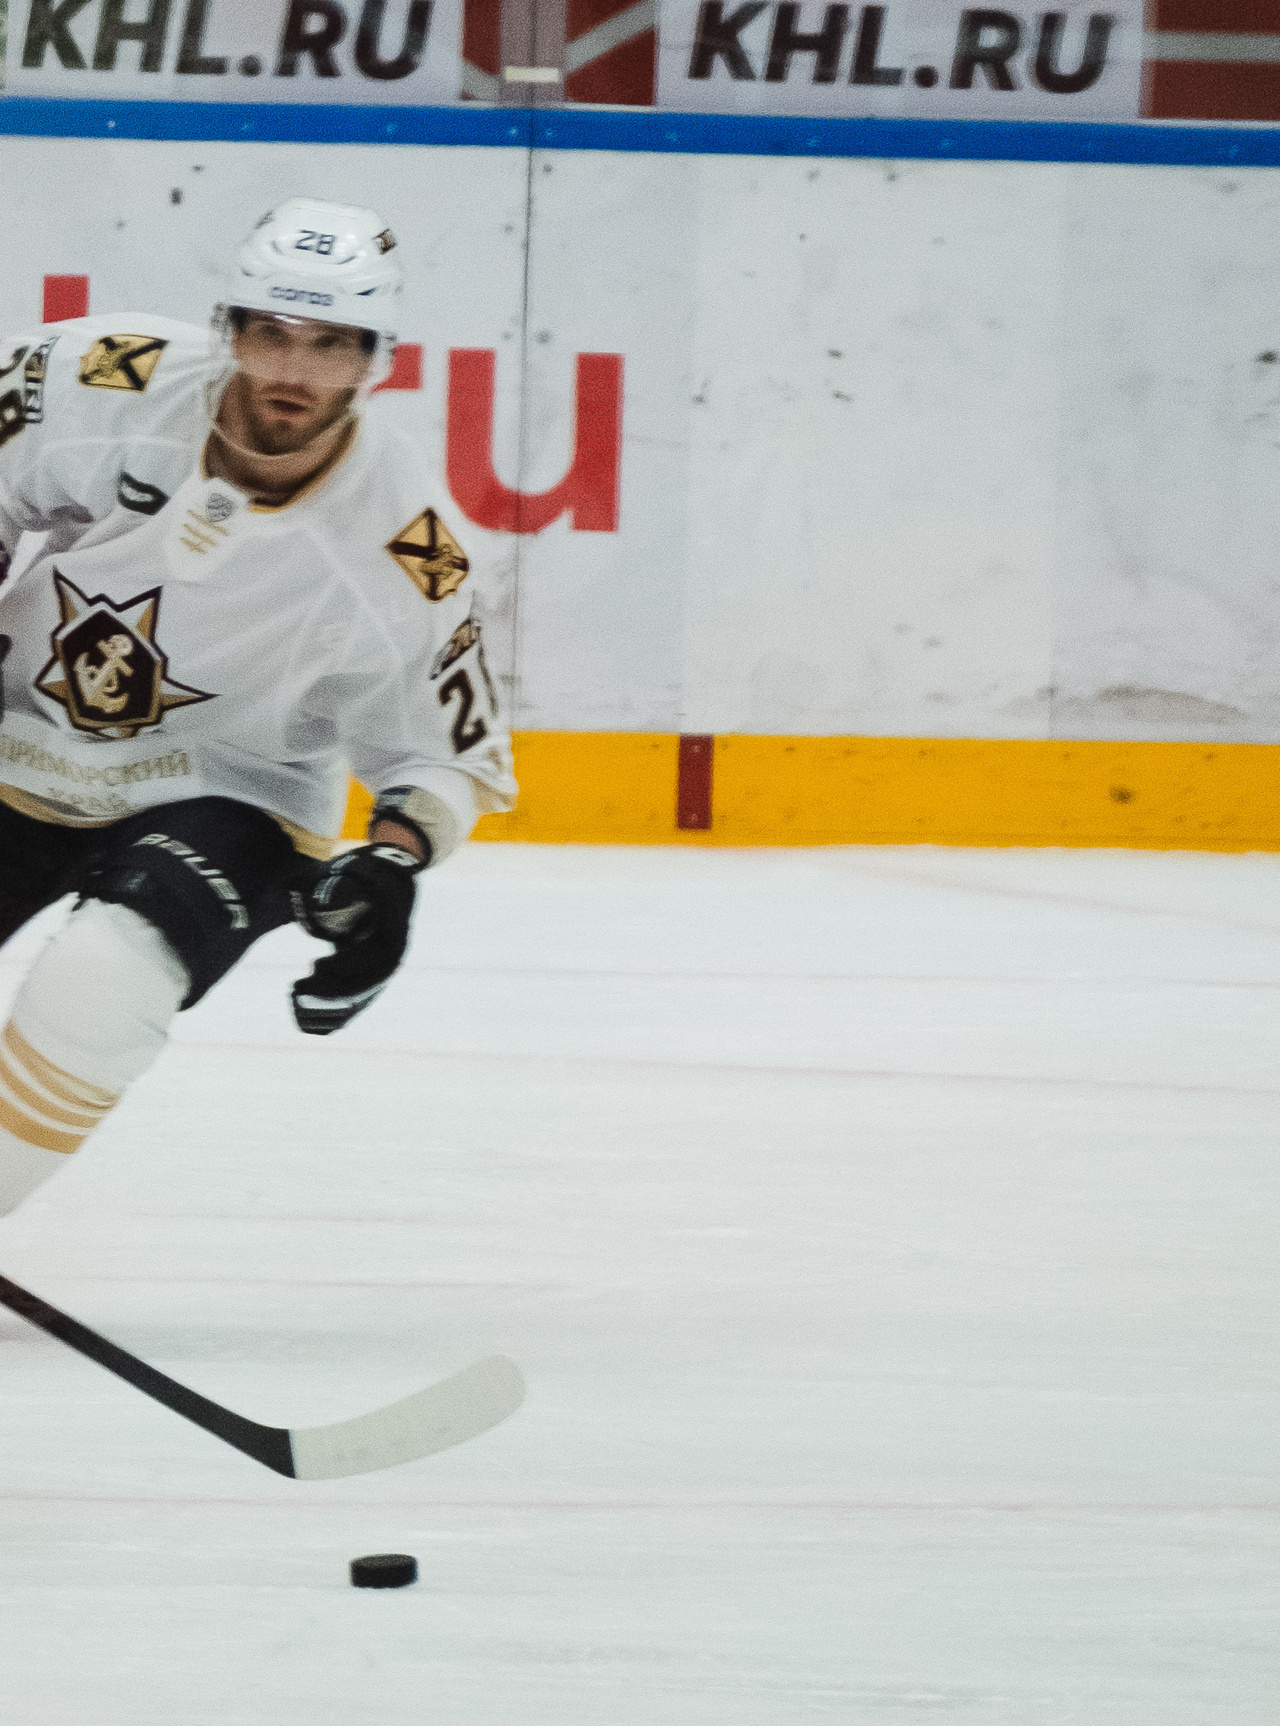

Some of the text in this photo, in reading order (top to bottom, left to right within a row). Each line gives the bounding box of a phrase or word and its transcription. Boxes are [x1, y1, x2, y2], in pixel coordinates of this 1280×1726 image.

[21, 0, 434, 81] KHL.RU
[687, 0, 1117, 95] KHL.RU
[293, 229, 337, 256] 28
